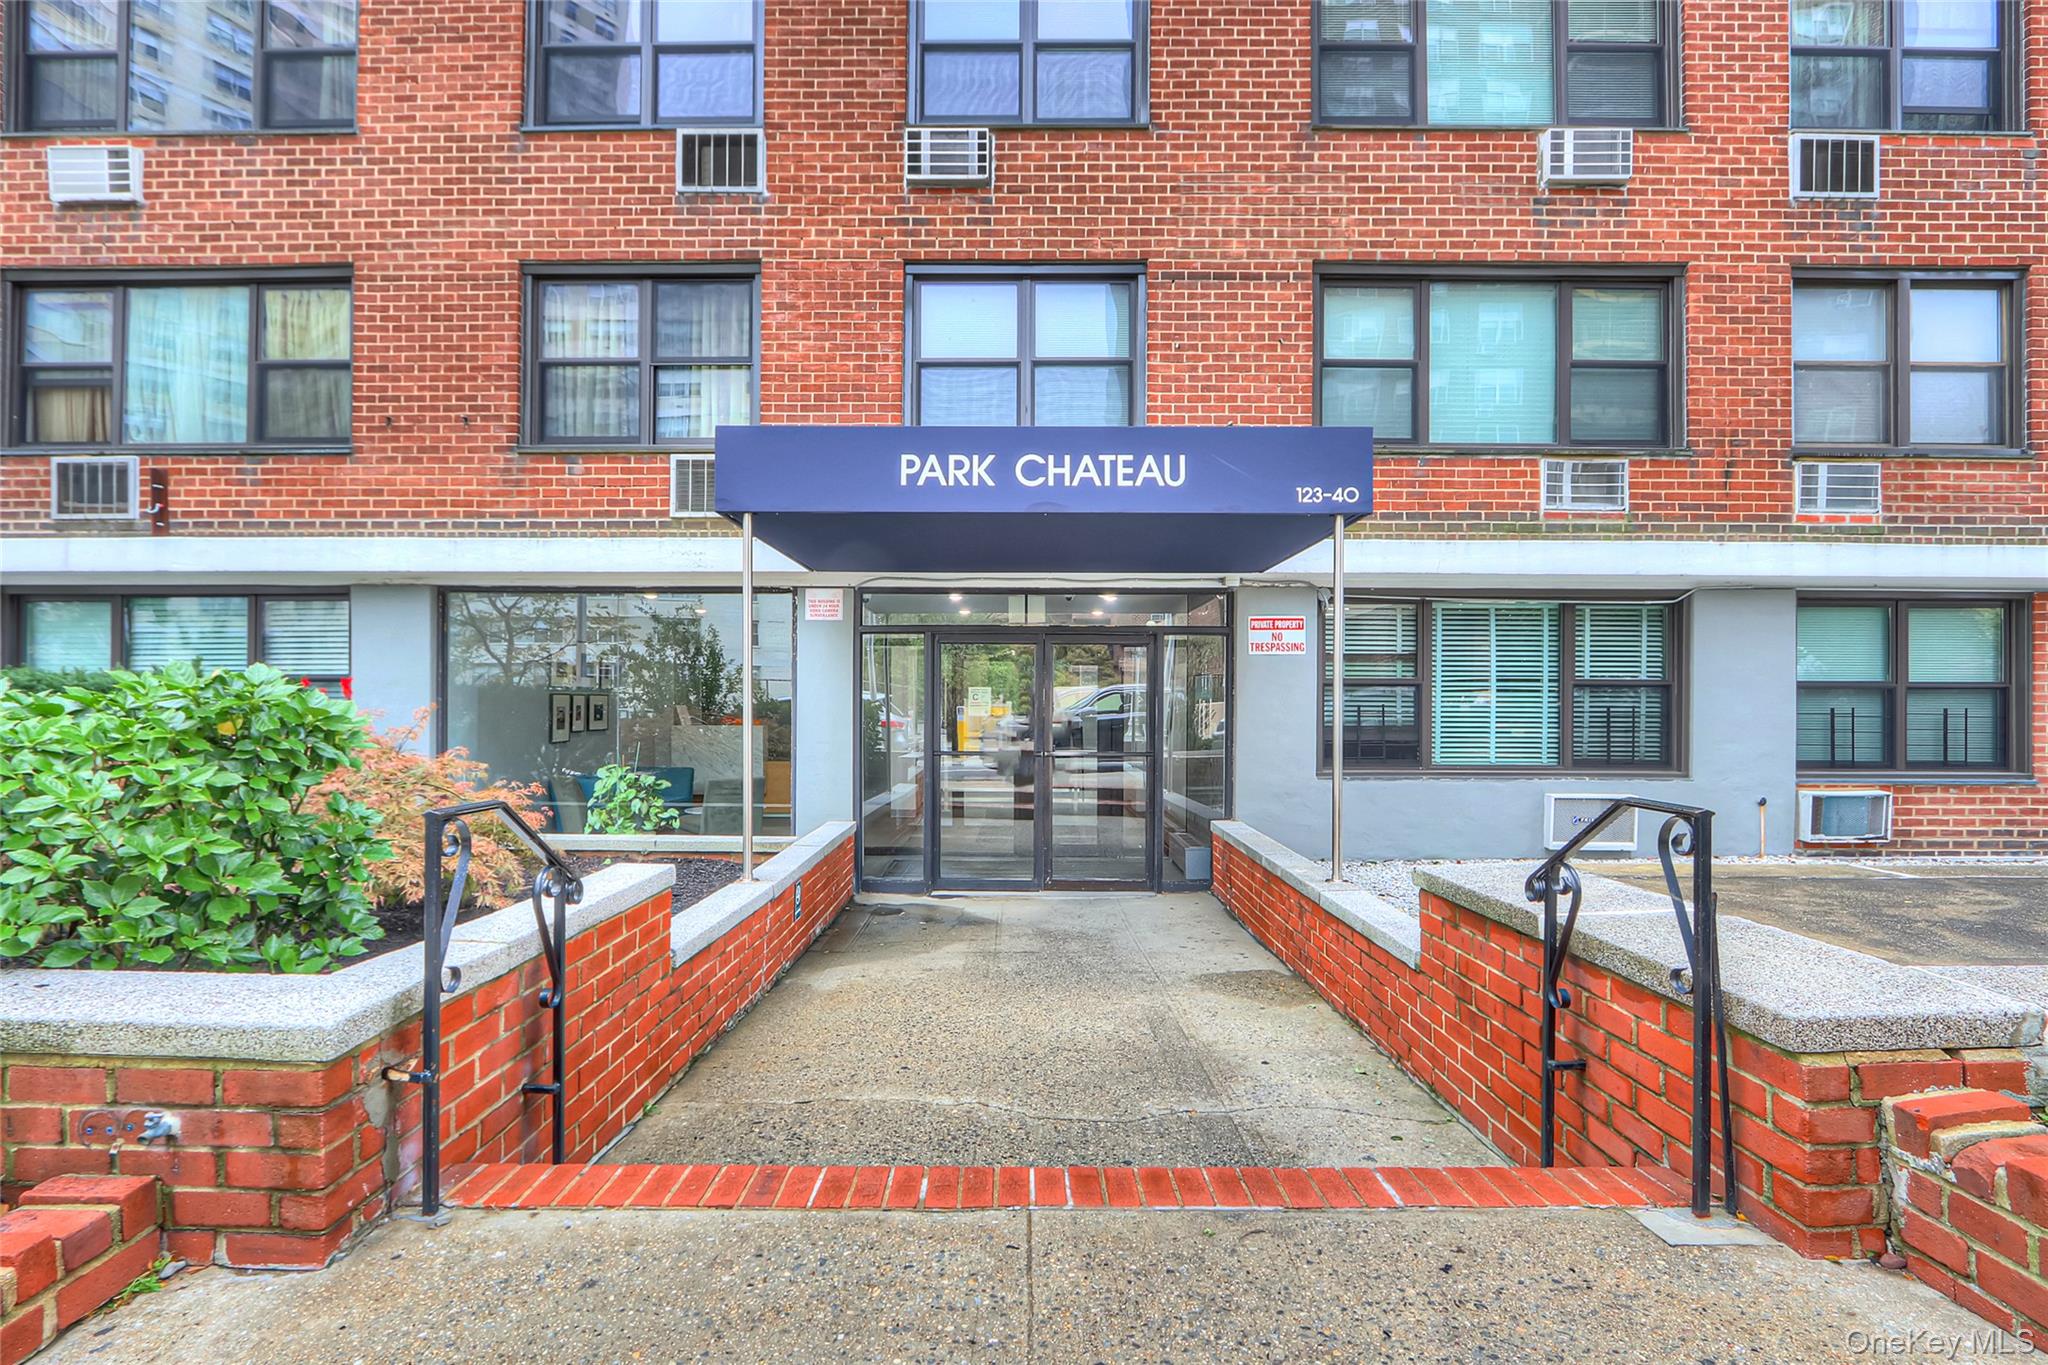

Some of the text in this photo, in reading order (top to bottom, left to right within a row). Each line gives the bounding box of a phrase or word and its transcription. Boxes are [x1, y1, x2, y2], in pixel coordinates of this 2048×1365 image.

[900, 454, 1186, 487] PARK CHATEAU
[1295, 487, 1360, 503] 123-40
[1250, 620, 1303, 629] PRIVATE PROPERTY
[1271, 632, 1283, 641] NO
[1250, 642, 1305, 652] TRESPASSING
